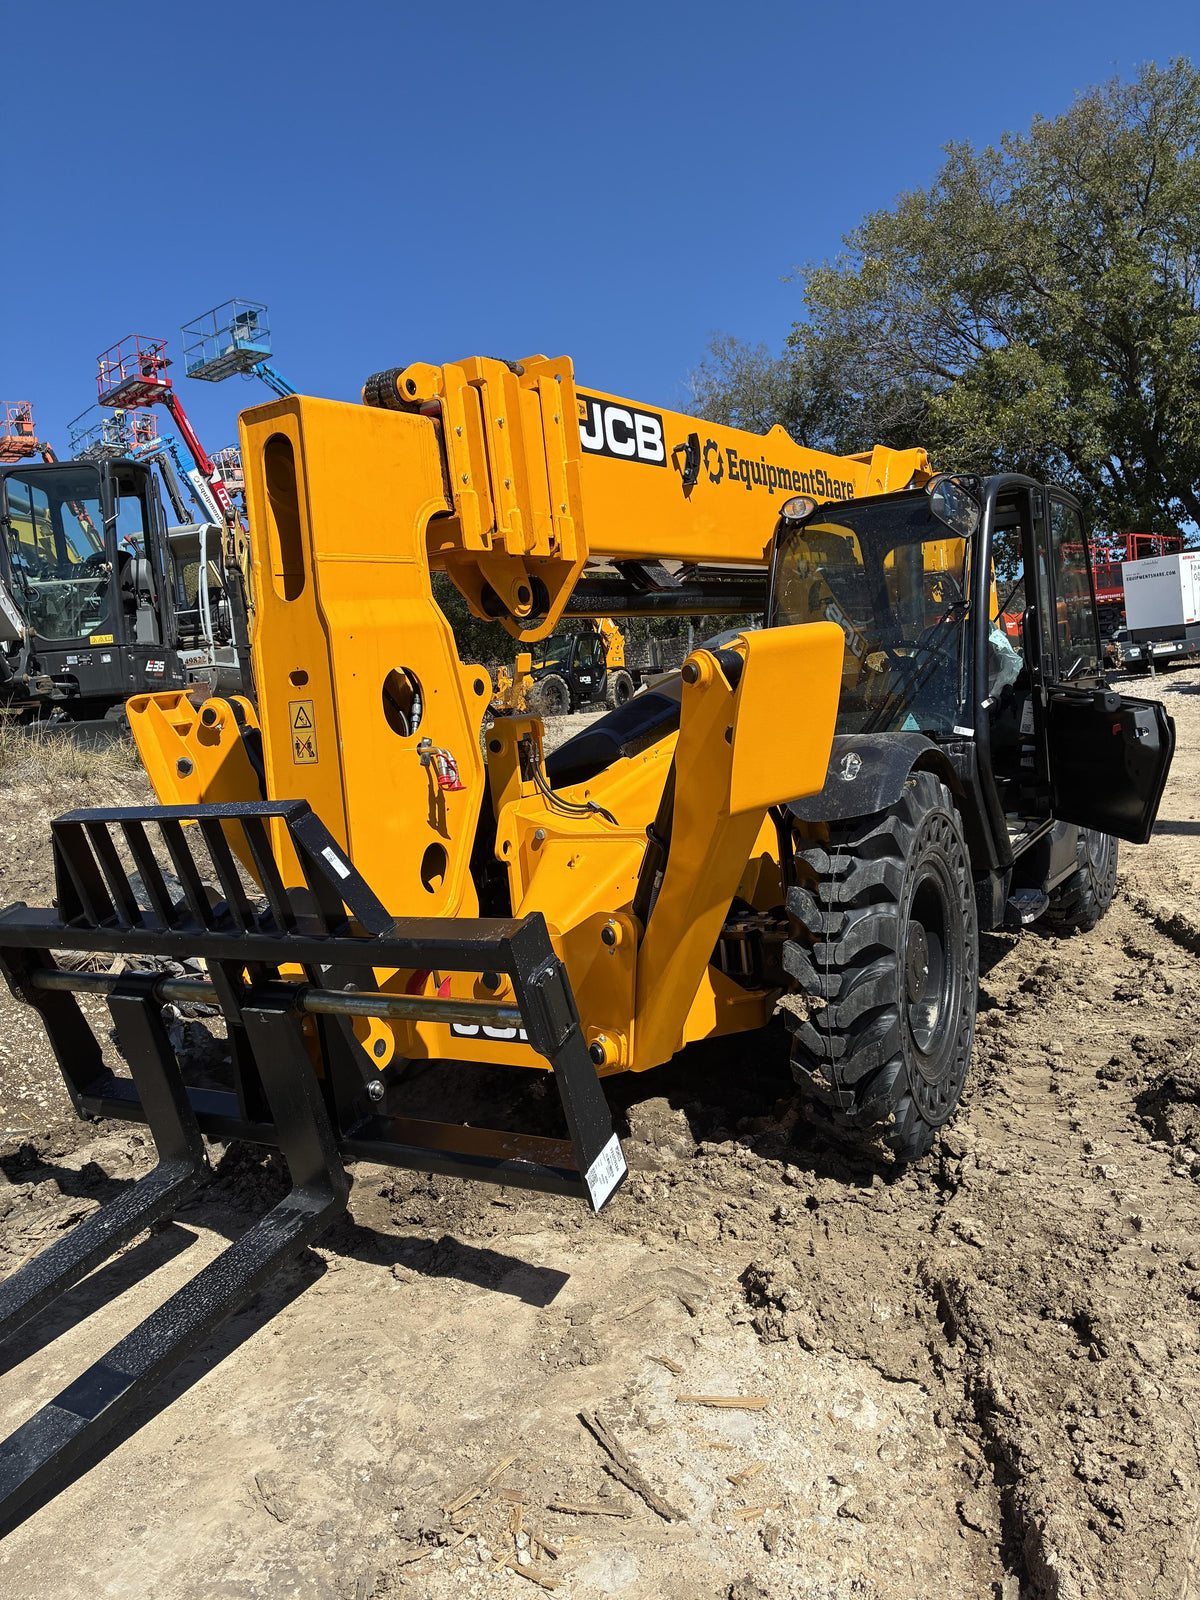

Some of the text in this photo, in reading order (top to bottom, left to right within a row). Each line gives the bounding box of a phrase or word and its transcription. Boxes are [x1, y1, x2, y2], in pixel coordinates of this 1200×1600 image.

[578, 403, 665, 462] JCB
[725, 448, 855, 500] EquipmentShare
[1126, 570, 1176, 581] EQUIPMENTSHARE.COM
[145, 660, 165, 672] E35
